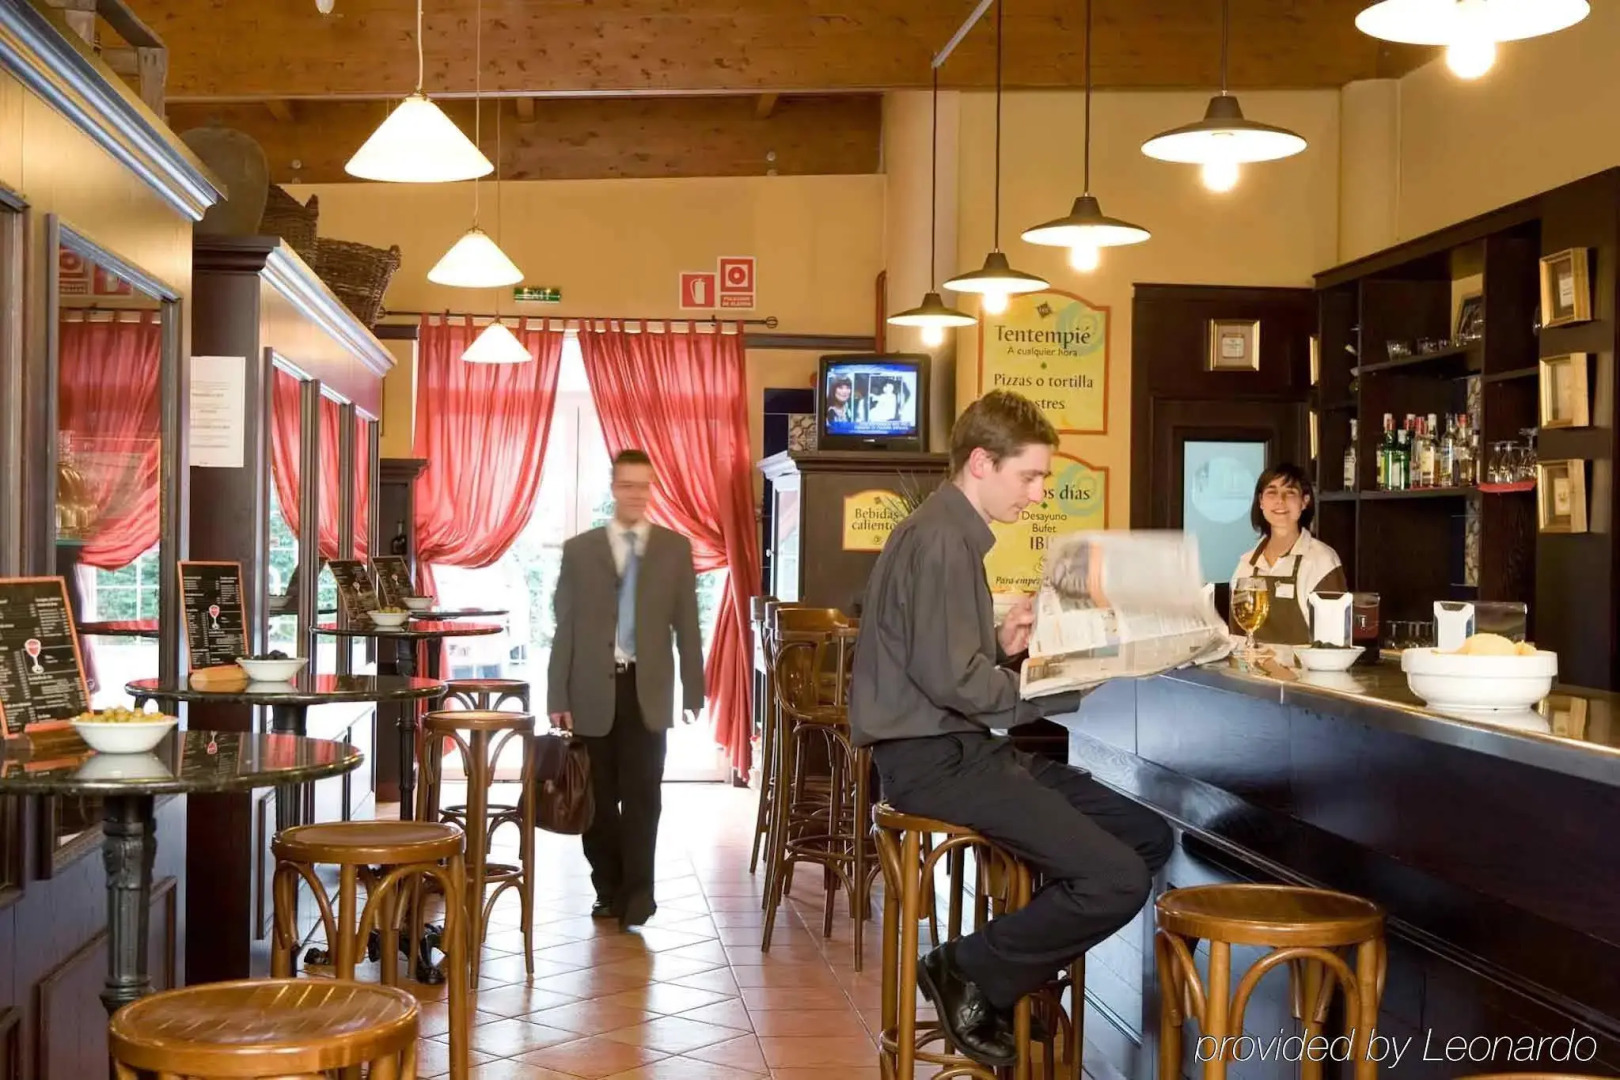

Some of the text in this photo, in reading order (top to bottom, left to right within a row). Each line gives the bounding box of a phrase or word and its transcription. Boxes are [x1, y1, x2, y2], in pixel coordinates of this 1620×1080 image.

[994, 325, 1091, 348] Tentempié
[1007, 346, 1078, 358] A cualquier hora
[994, 373, 1093, 388] Pizzas o tortilla
[855, 507, 899, 520] Bebidas
[1021, 510, 1068, 523] Desayuno
[1032, 523, 1057, 533] Bufet
[995, 576, 1014, 585] Para
